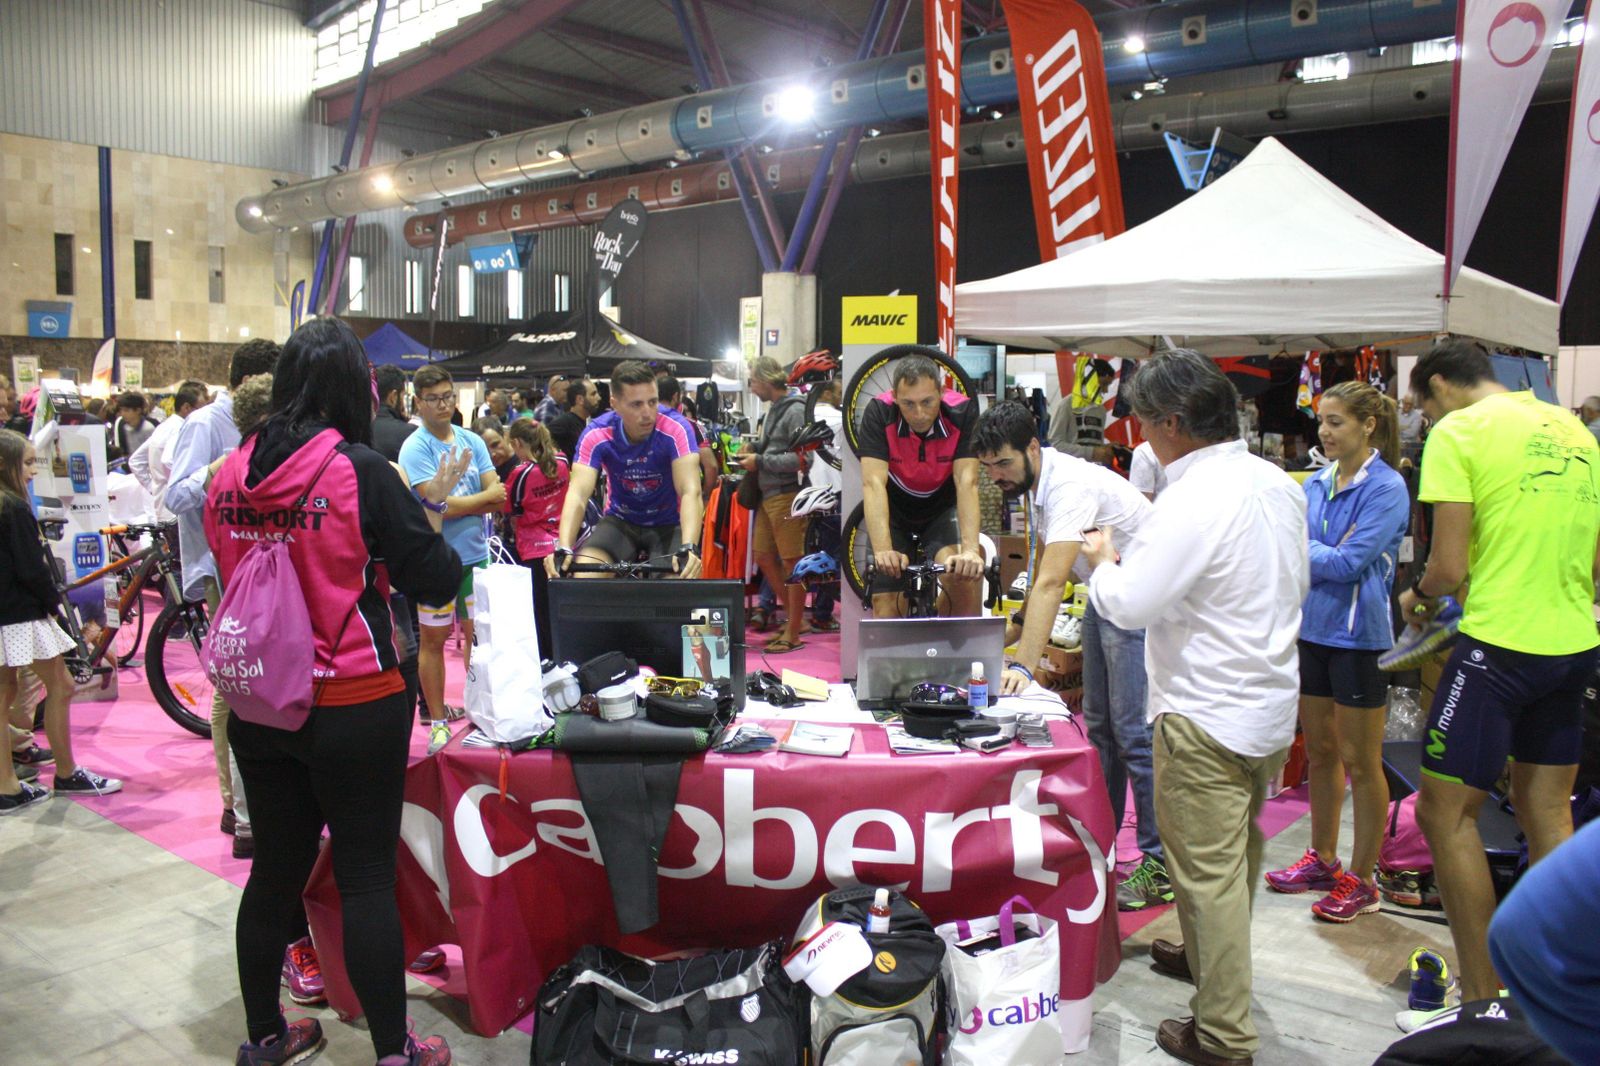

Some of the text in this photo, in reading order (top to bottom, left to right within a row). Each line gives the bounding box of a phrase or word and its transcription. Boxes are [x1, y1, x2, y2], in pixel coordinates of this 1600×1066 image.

[593, 231, 622, 255] Rock
[851, 314, 908, 326] MAVIC
[238, 657, 264, 678] Sol
[1437, 669, 1467, 731] movistar
[654, 1048, 739, 1066] K-WISS
